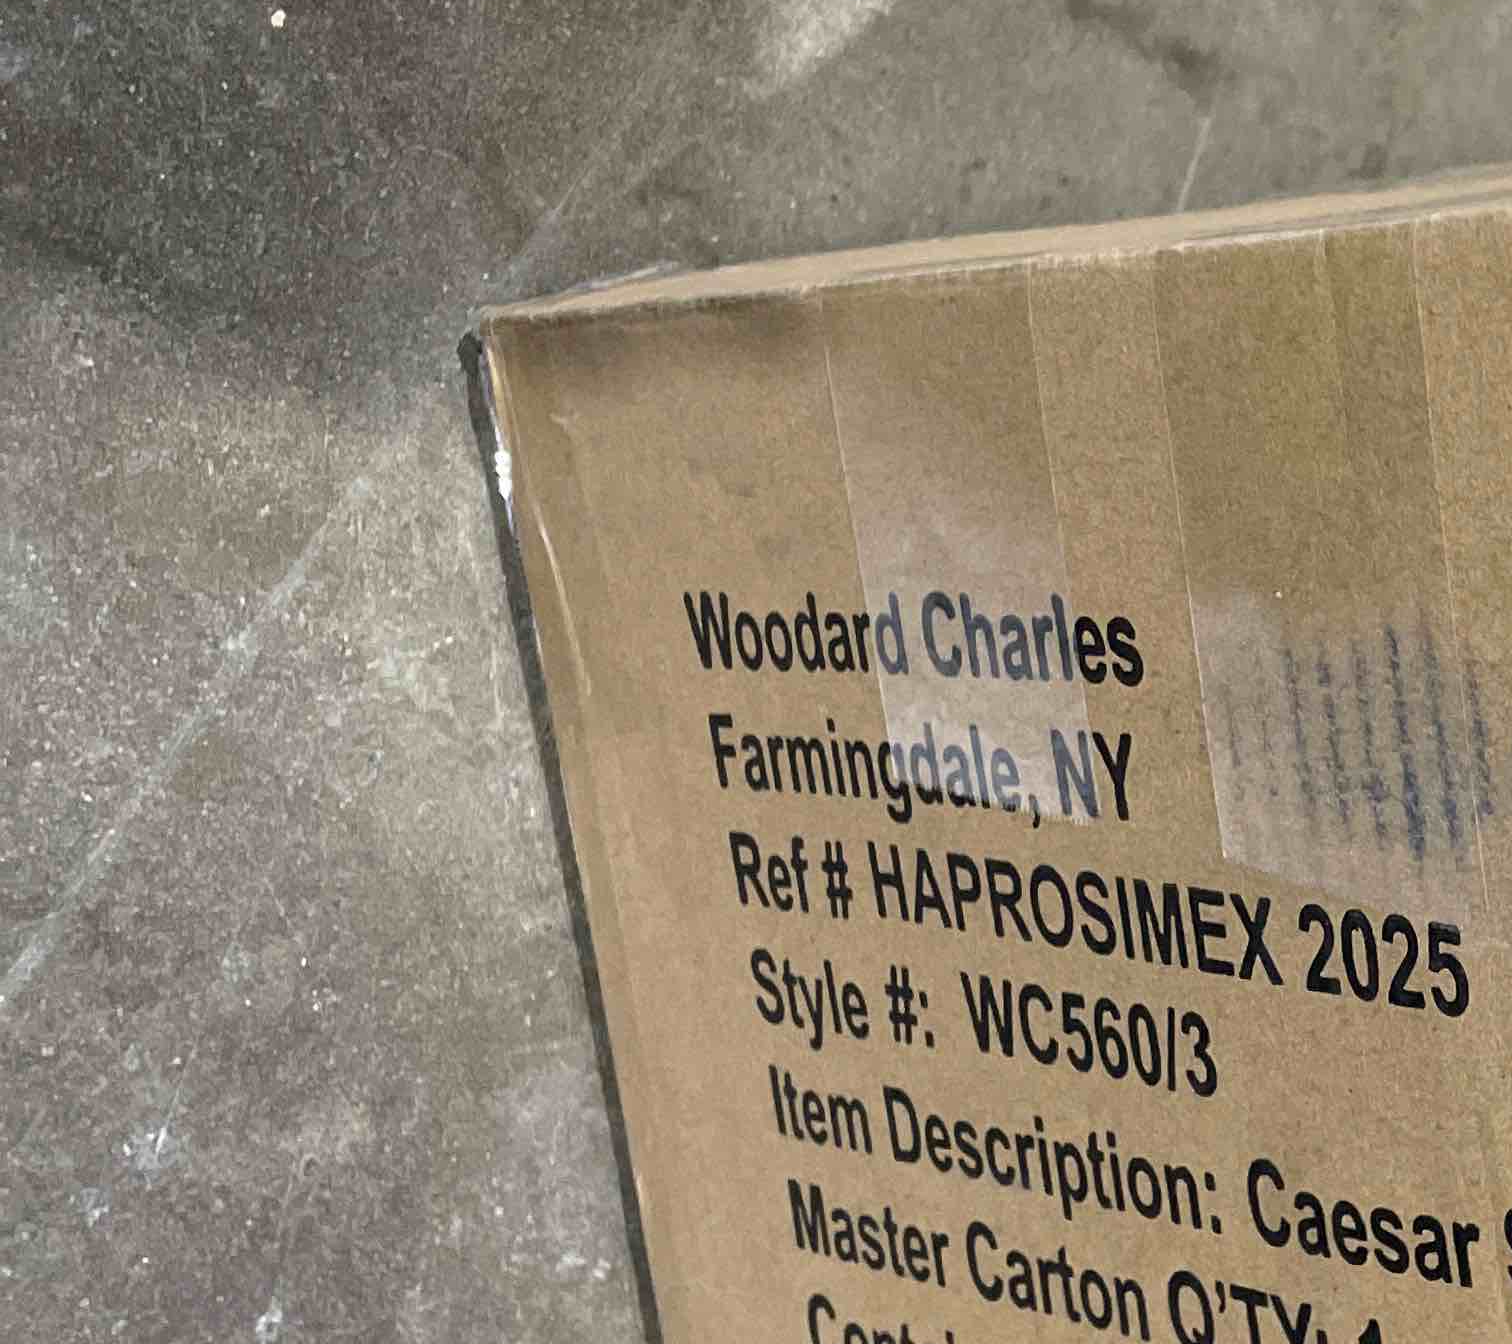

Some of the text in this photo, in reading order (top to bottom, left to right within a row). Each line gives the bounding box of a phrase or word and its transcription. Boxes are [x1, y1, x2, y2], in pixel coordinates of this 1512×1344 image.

[684, 590, 1145, 687] Woodard Charles
[708, 712, 1133, 828] Farmingdale, NY
[728, 831, 1470, 1019] Ref # HAPROSIMEX 2025
[749, 947, 1217, 1097] Style #: WC560/3
[769, 1064, 872, 1155] Item
[883, 1086, 1223, 1234] Description:
[1247, 1159, 1480, 1289] Caesar
[787, 1178, 948, 1287] Master
[966, 1221, 1150, 1342] Carton
